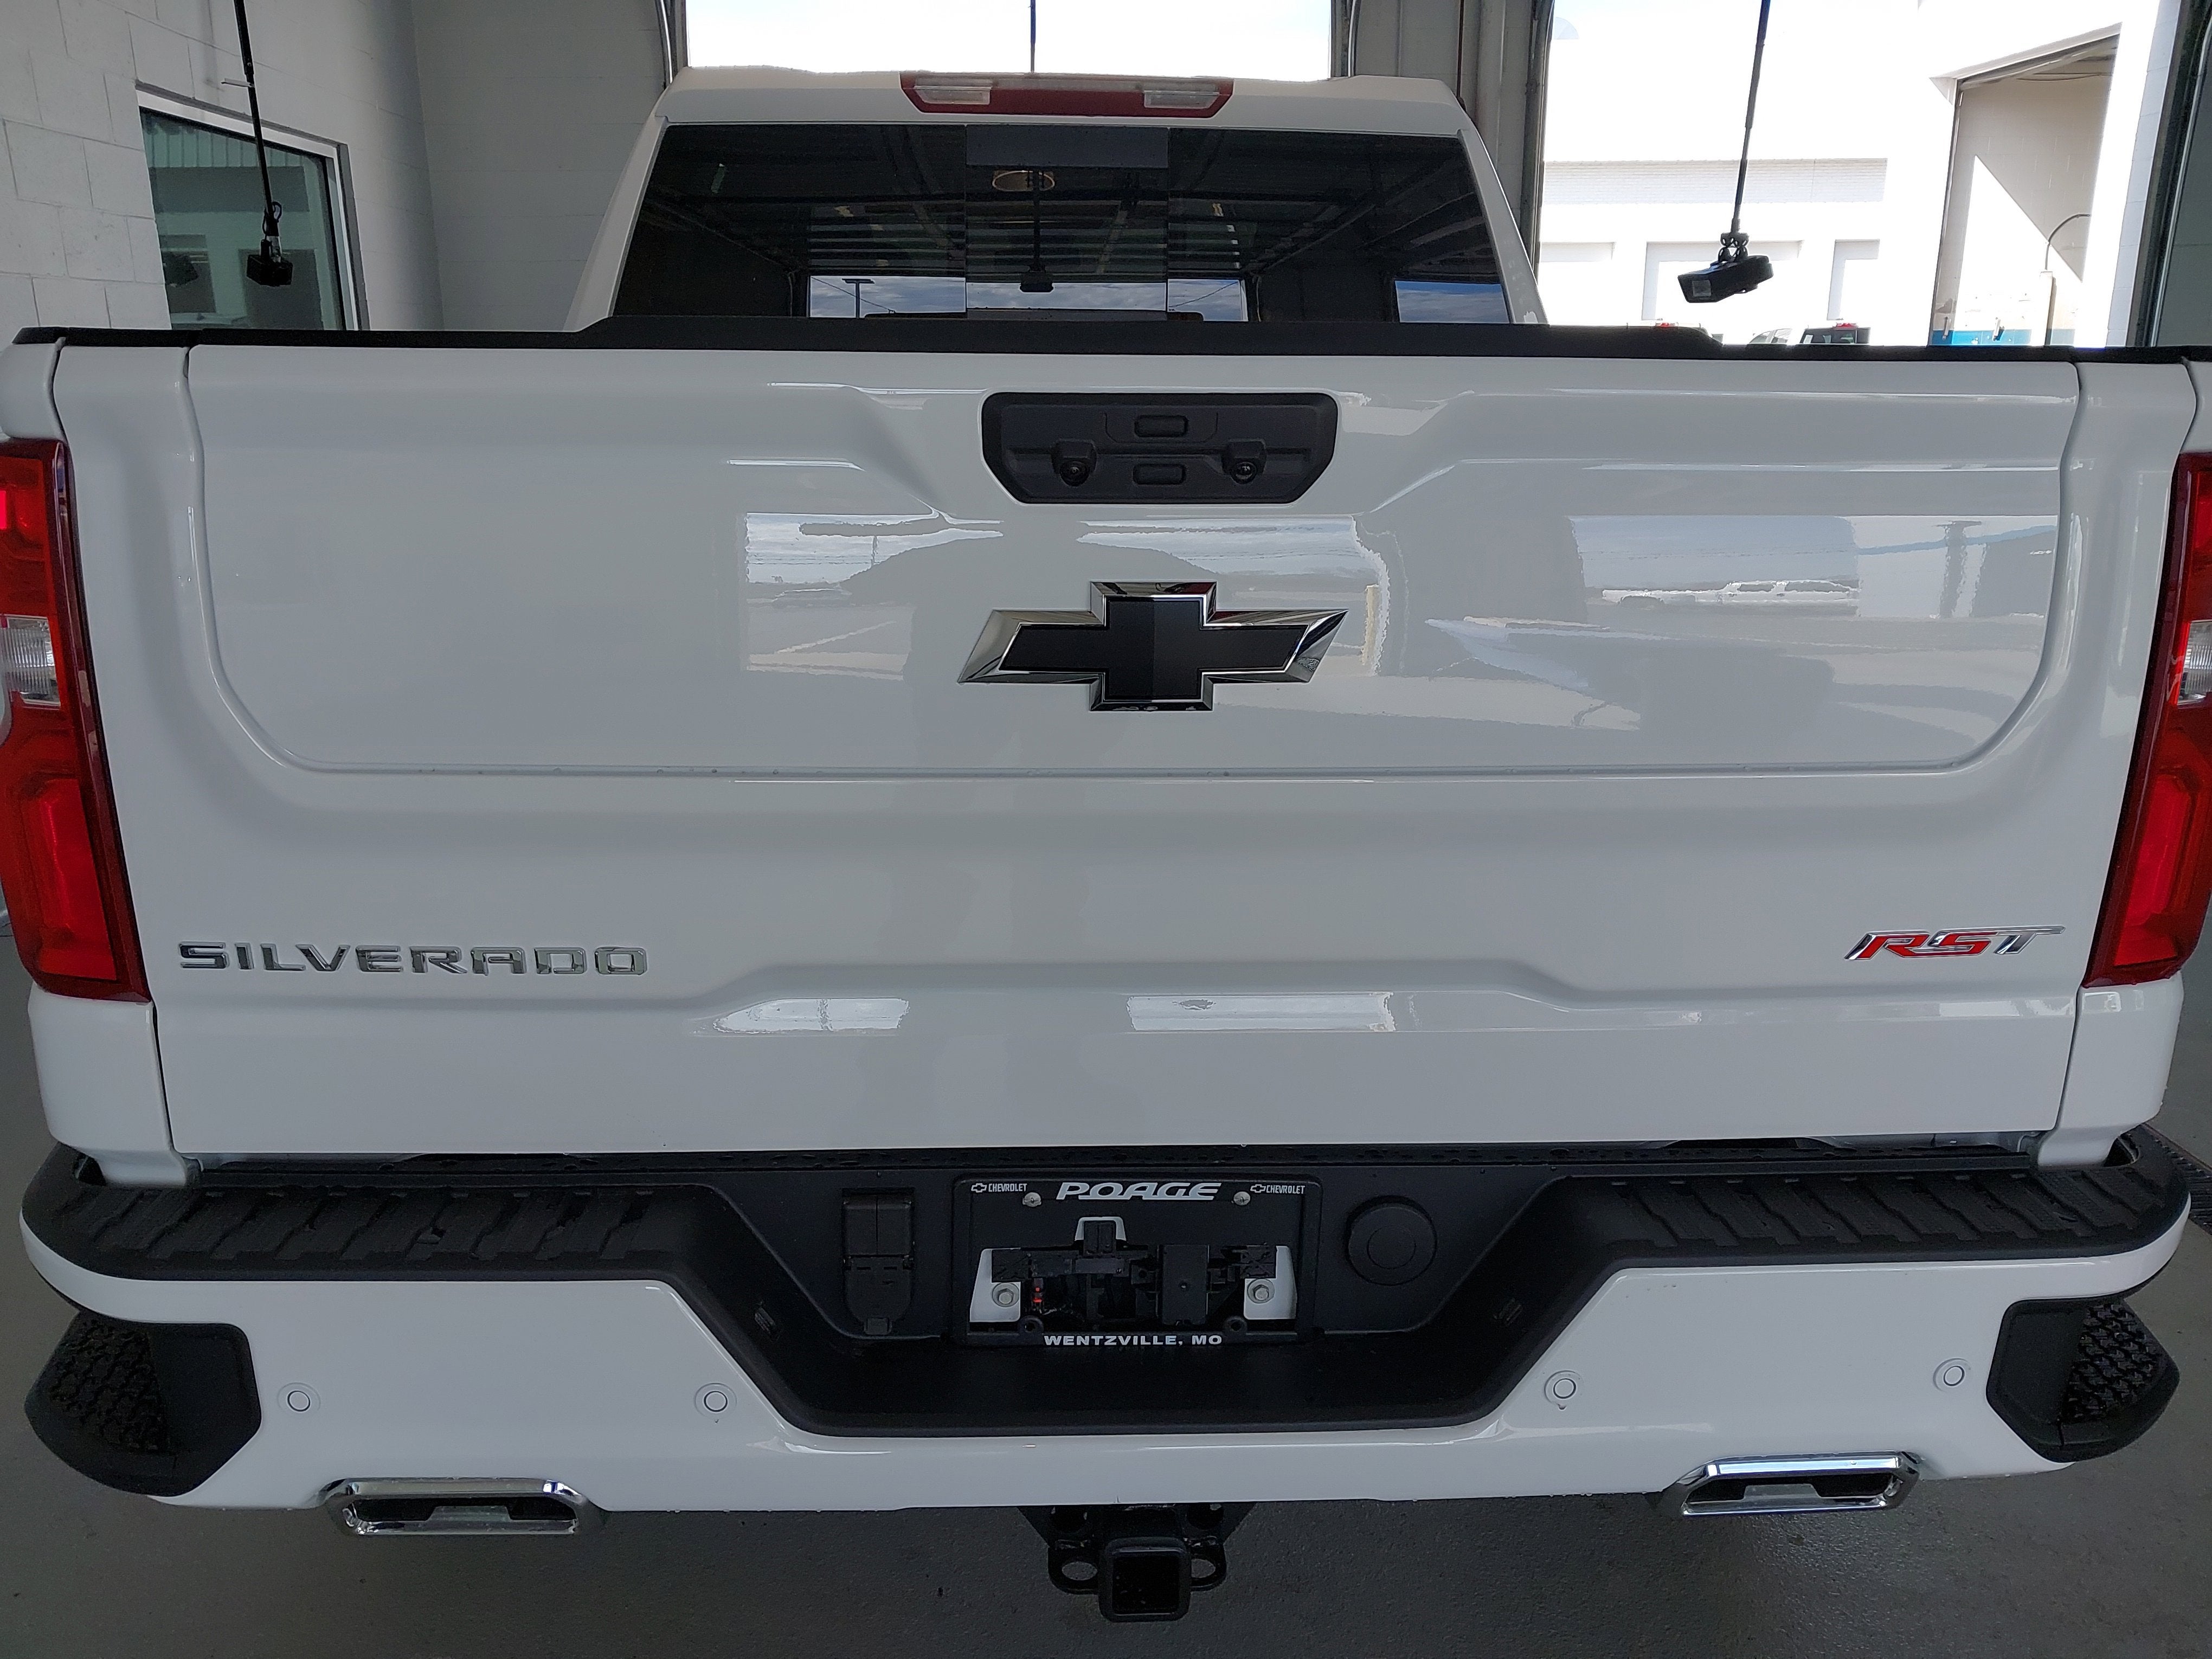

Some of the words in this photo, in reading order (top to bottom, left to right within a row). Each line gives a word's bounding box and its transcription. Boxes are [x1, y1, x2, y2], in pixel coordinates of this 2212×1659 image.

[1844, 925, 2066, 960] RST
[178, 941, 648, 976] SILVERADO
[988, 1183, 1027, 1193] CHEVROLET
[1056, 1182, 1221, 1200] POAGE
[1266, 1184, 1306, 1194] CHEVROLET
[1044, 1335, 1184, 1346] WENTZVILLE,
[1192, 1335, 1222, 1345] MO
